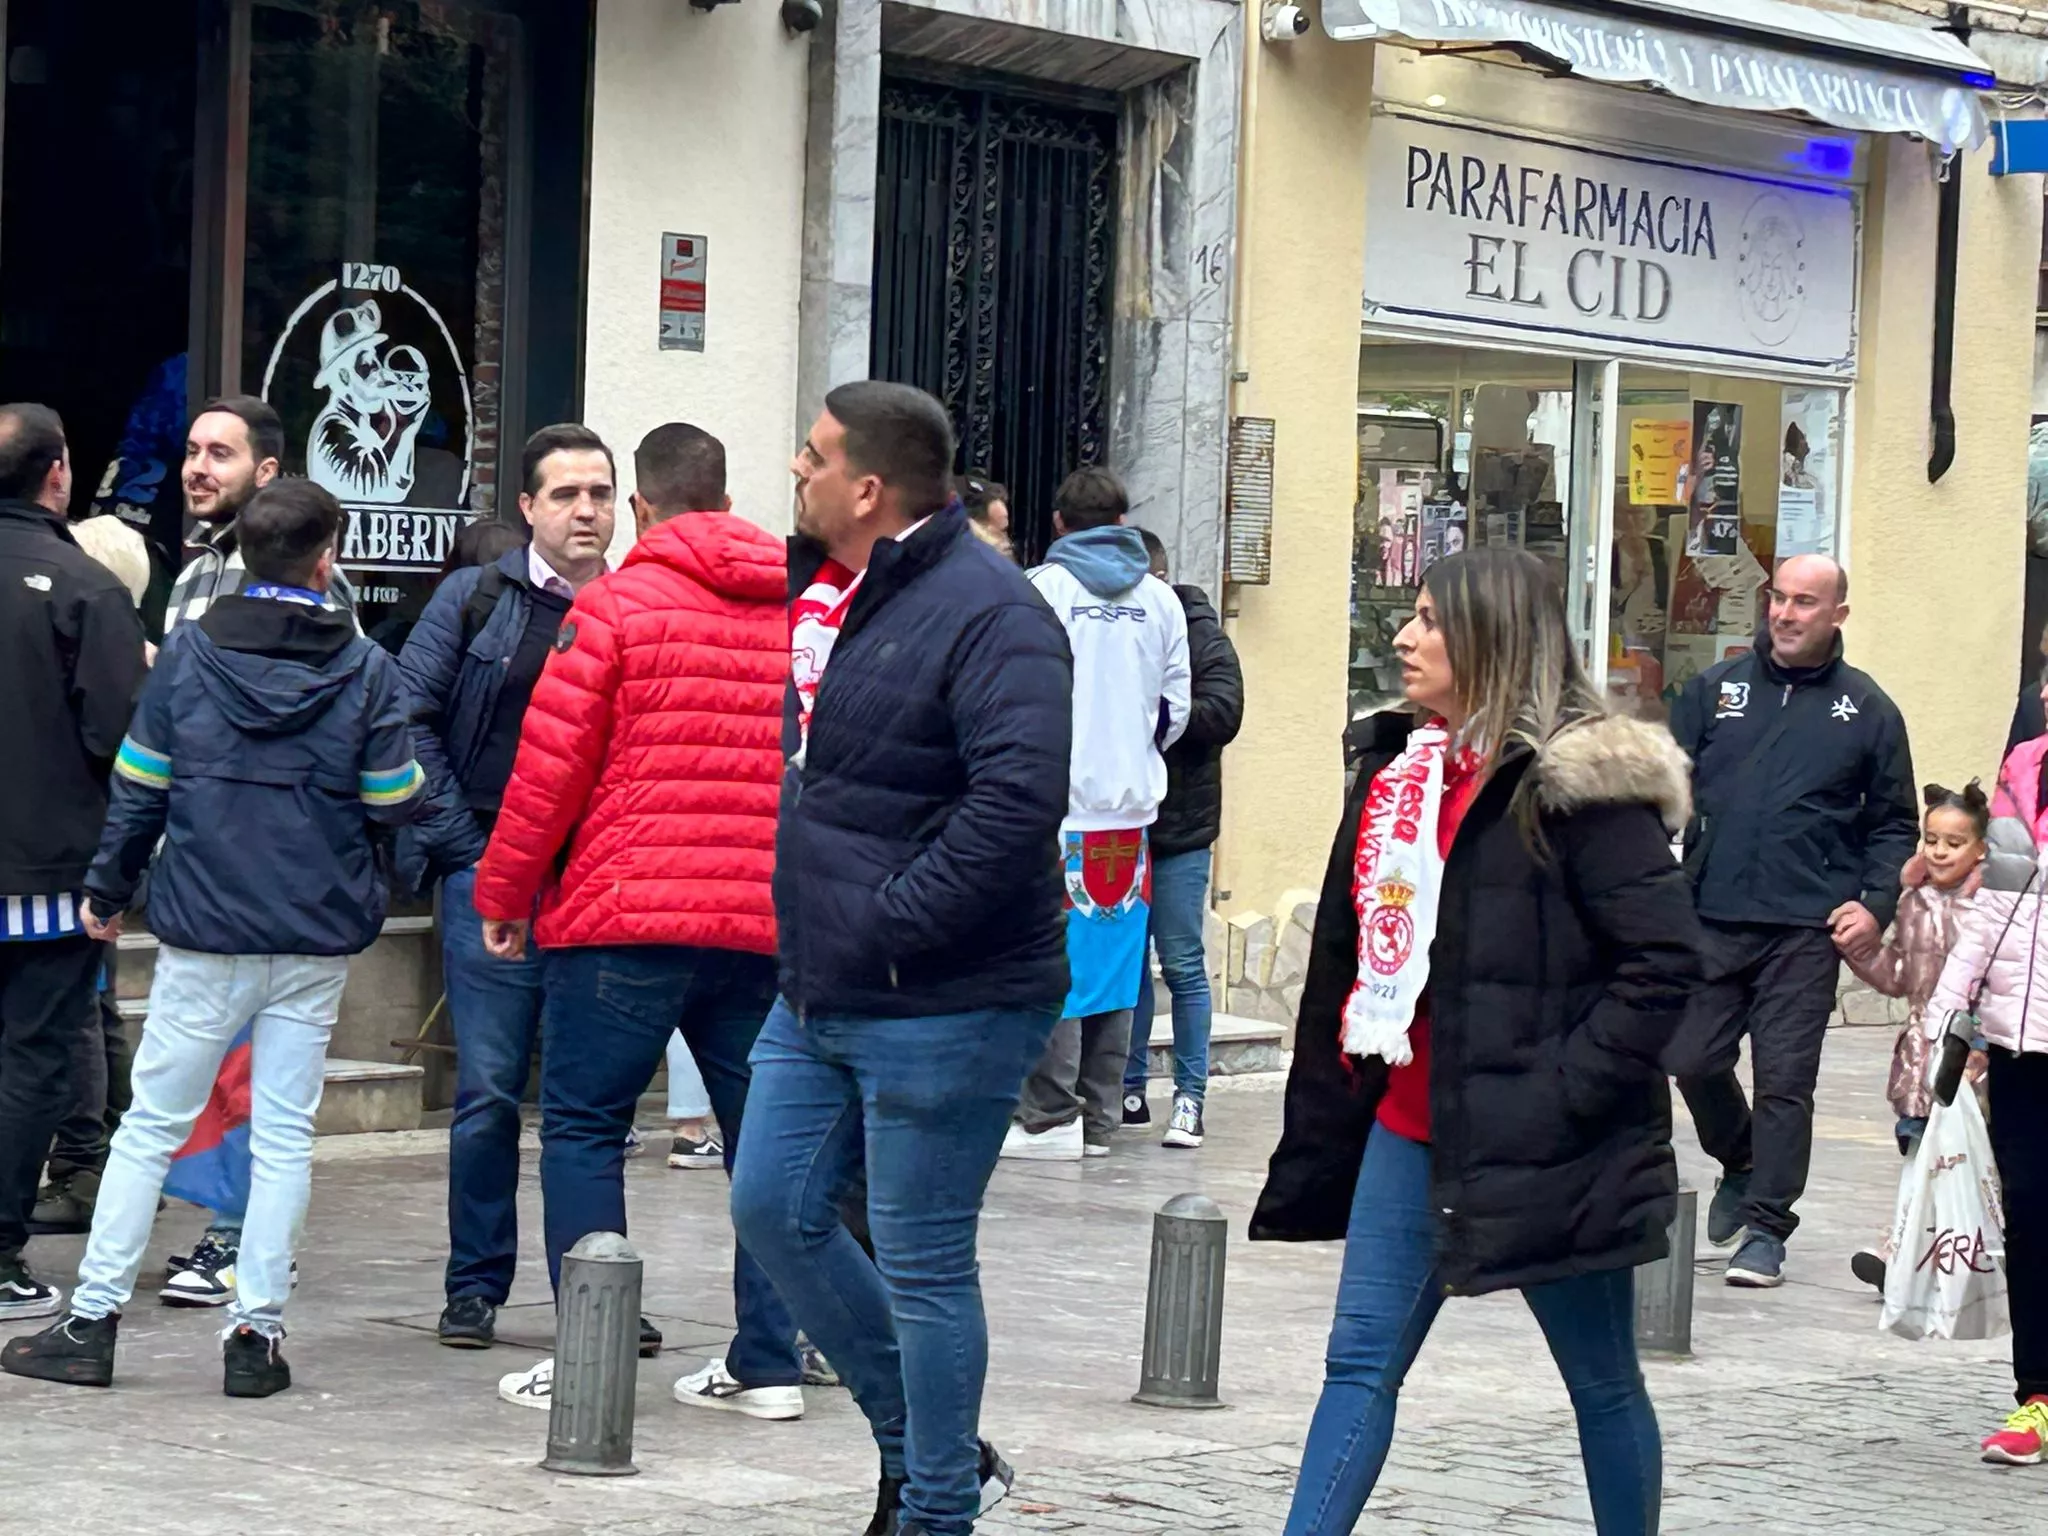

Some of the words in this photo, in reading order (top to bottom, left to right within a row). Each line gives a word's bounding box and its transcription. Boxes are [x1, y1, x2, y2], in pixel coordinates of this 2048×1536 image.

[1406, 145, 1717, 260] PARAFARMACIA
[342, 262, 401, 293] 1270
[1195, 243, 1222, 288] 16
[1464, 233, 1545, 309] EL
[1567, 247, 1673, 324] CID
[340, 510, 477, 562] ABERN
